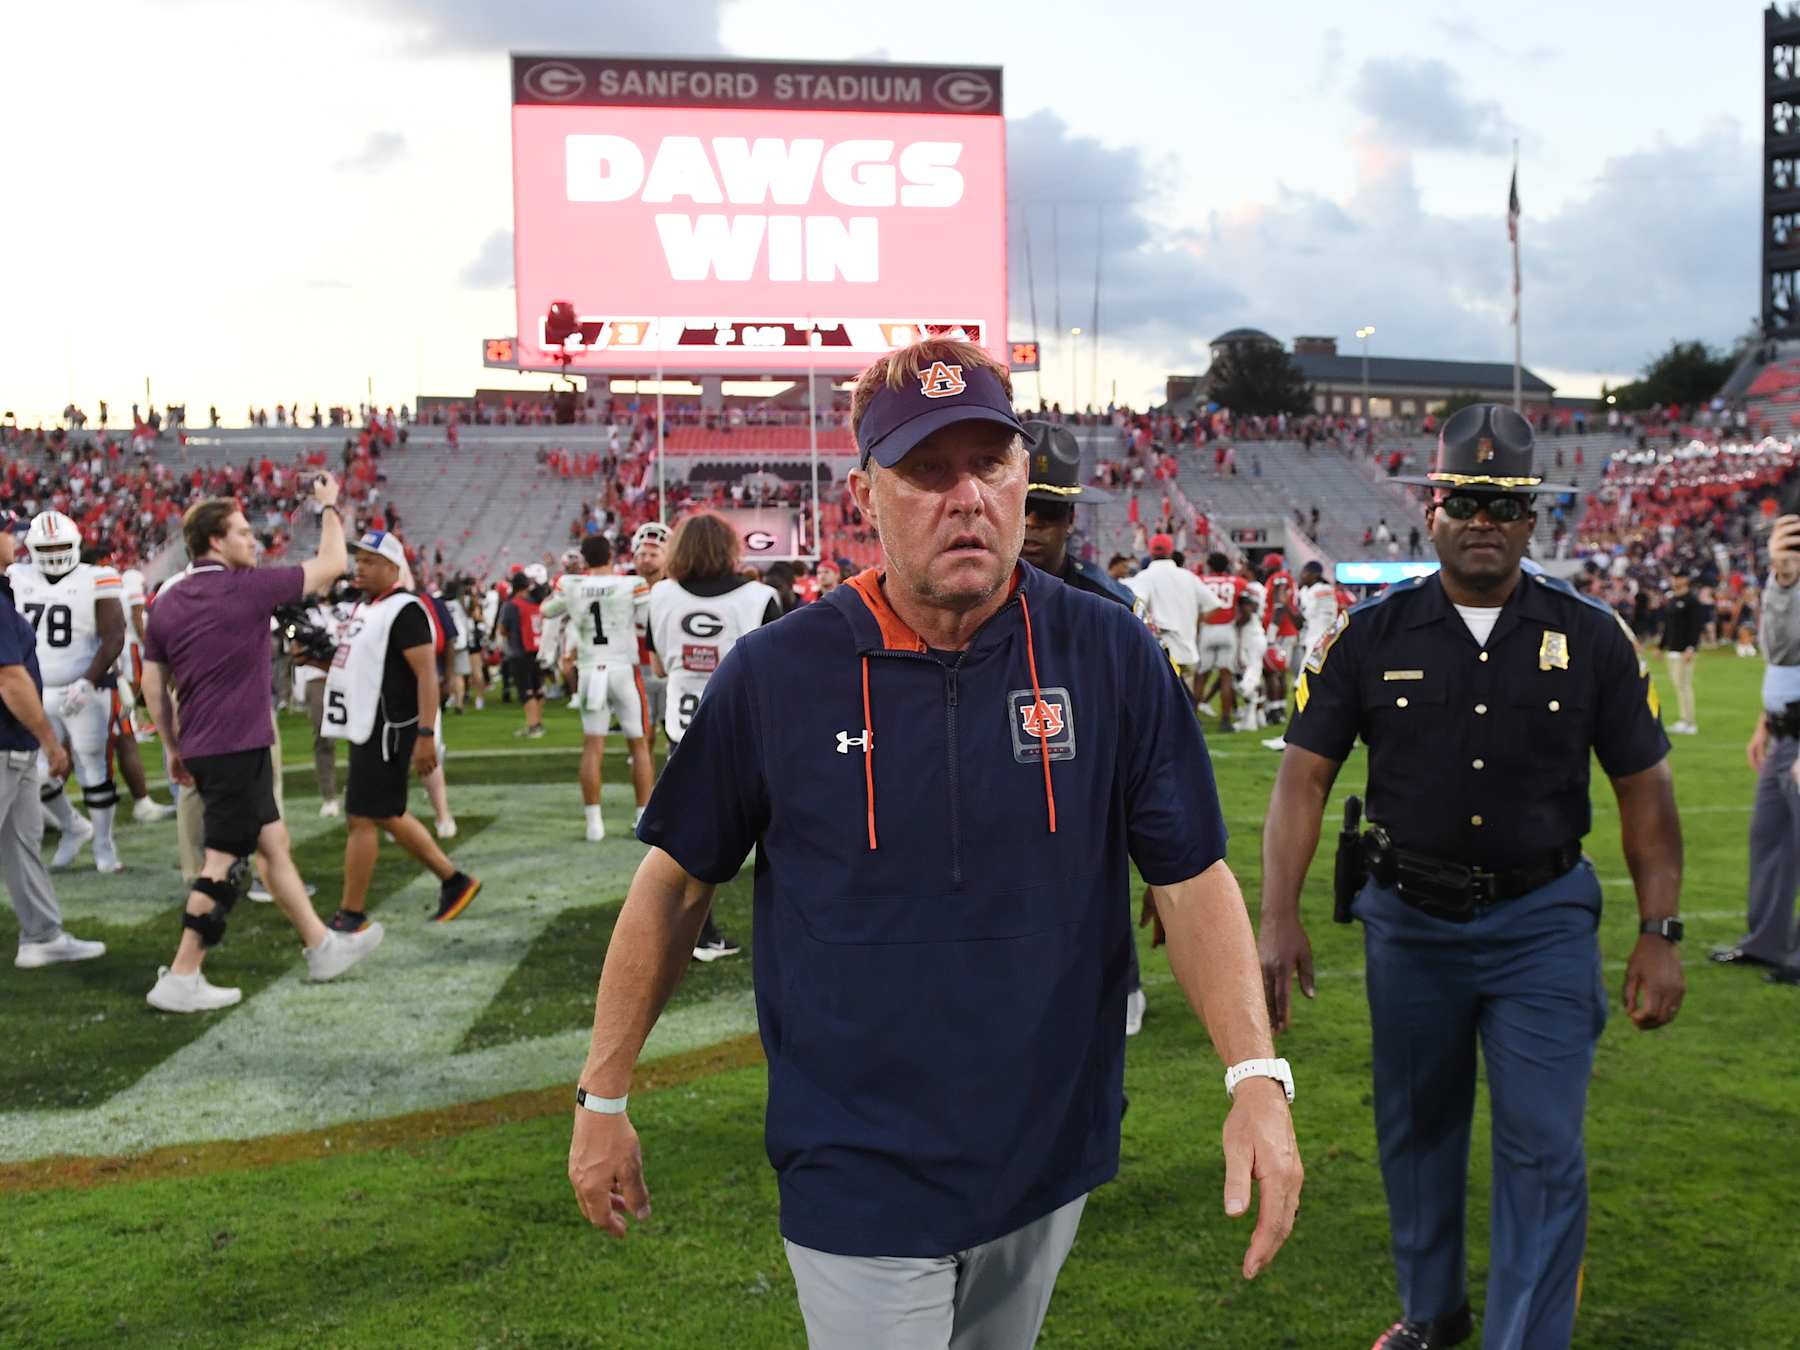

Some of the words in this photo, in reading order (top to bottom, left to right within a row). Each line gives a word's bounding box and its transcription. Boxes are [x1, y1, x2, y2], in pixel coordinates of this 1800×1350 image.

[600, 69, 759, 99] SANFORD
[774, 73, 922, 103] STADIUM
[565, 134, 965, 208] DAWGS
[655, 213, 879, 283] WIN
[24, 603, 72, 648] 78
[590, 601, 608, 645] 1
[681, 611, 724, 638] G
[327, 691, 348, 726] 5
[679, 693, 700, 730] 9
